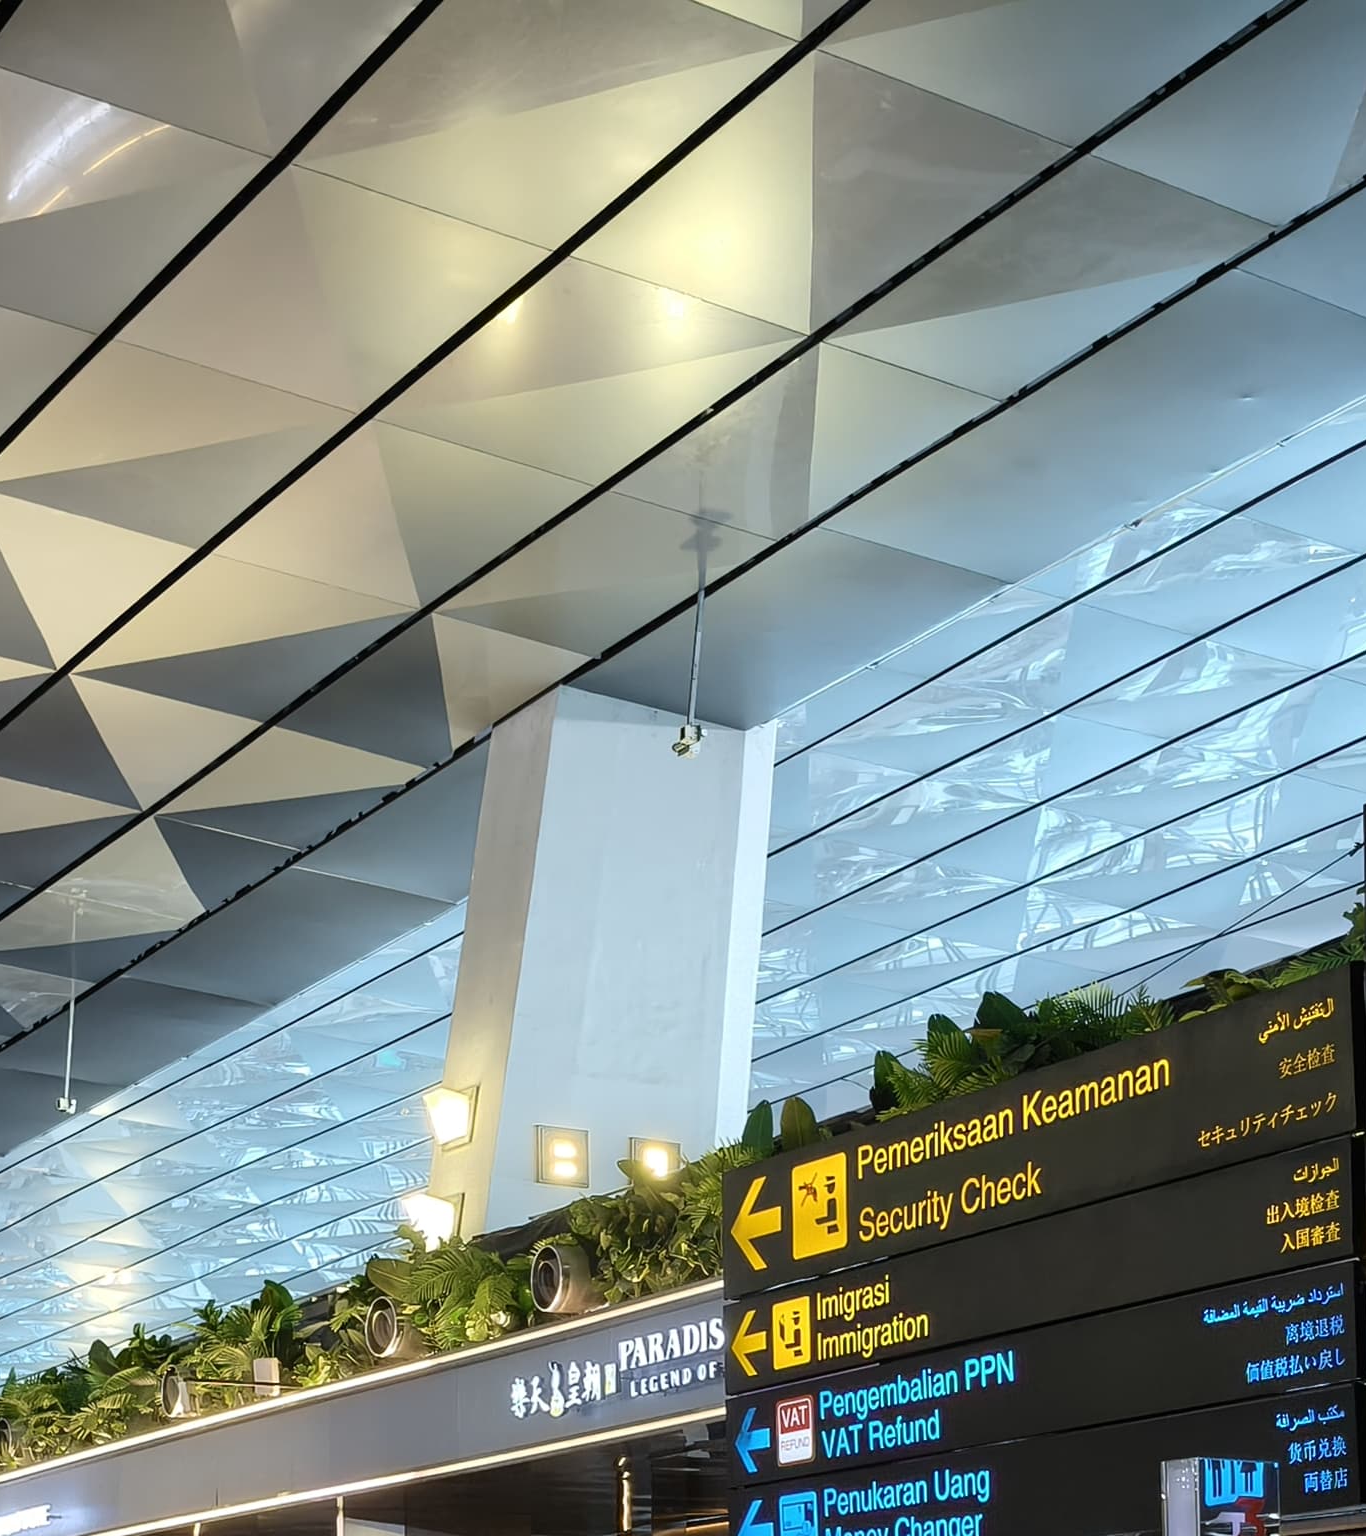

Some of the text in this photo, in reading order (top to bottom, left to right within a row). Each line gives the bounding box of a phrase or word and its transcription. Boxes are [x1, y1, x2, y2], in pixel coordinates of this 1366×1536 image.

[1258, 997, 1335, 1044] التفتيش الأمني
[1278, 1043, 1336, 1080] 安全检查
[857, 1058, 1170, 1180] Pemeriksaan Keamanan
[1197, 1091, 1338, 1148] セキュリティチェック
[1292, 1157, 1340, 1183] الجوازات
[858, 1160, 1042, 1242] Security Check
[1266, 1189, 1340, 1225] 出入境检查
[1280, 1222, 1341, 1254] 入国審査
[816, 1275, 890, 1321] Imigrasi
[618, 1318, 725, 1372] PARADIS
[816, 1313, 929, 1361] Immigration
[1285, 1314, 1345, 1346] 离境退税
[630, 1367, 692, 1397] LEGEND
[696, 1361, 718, 1382] OF
[818, 1349, 1015, 1422] Pengembalian PPN
[781, 1405, 808, 1429] VAT
[821, 1410, 941, 1460] VAT Refund
[780, 1436, 811, 1452] REFUND
[1288, 1436, 1347, 1465] 货币兑换
[823, 1468, 991, 1519] Penukaran Uang
[1303, 1467, 1348, 1494] 両替店
